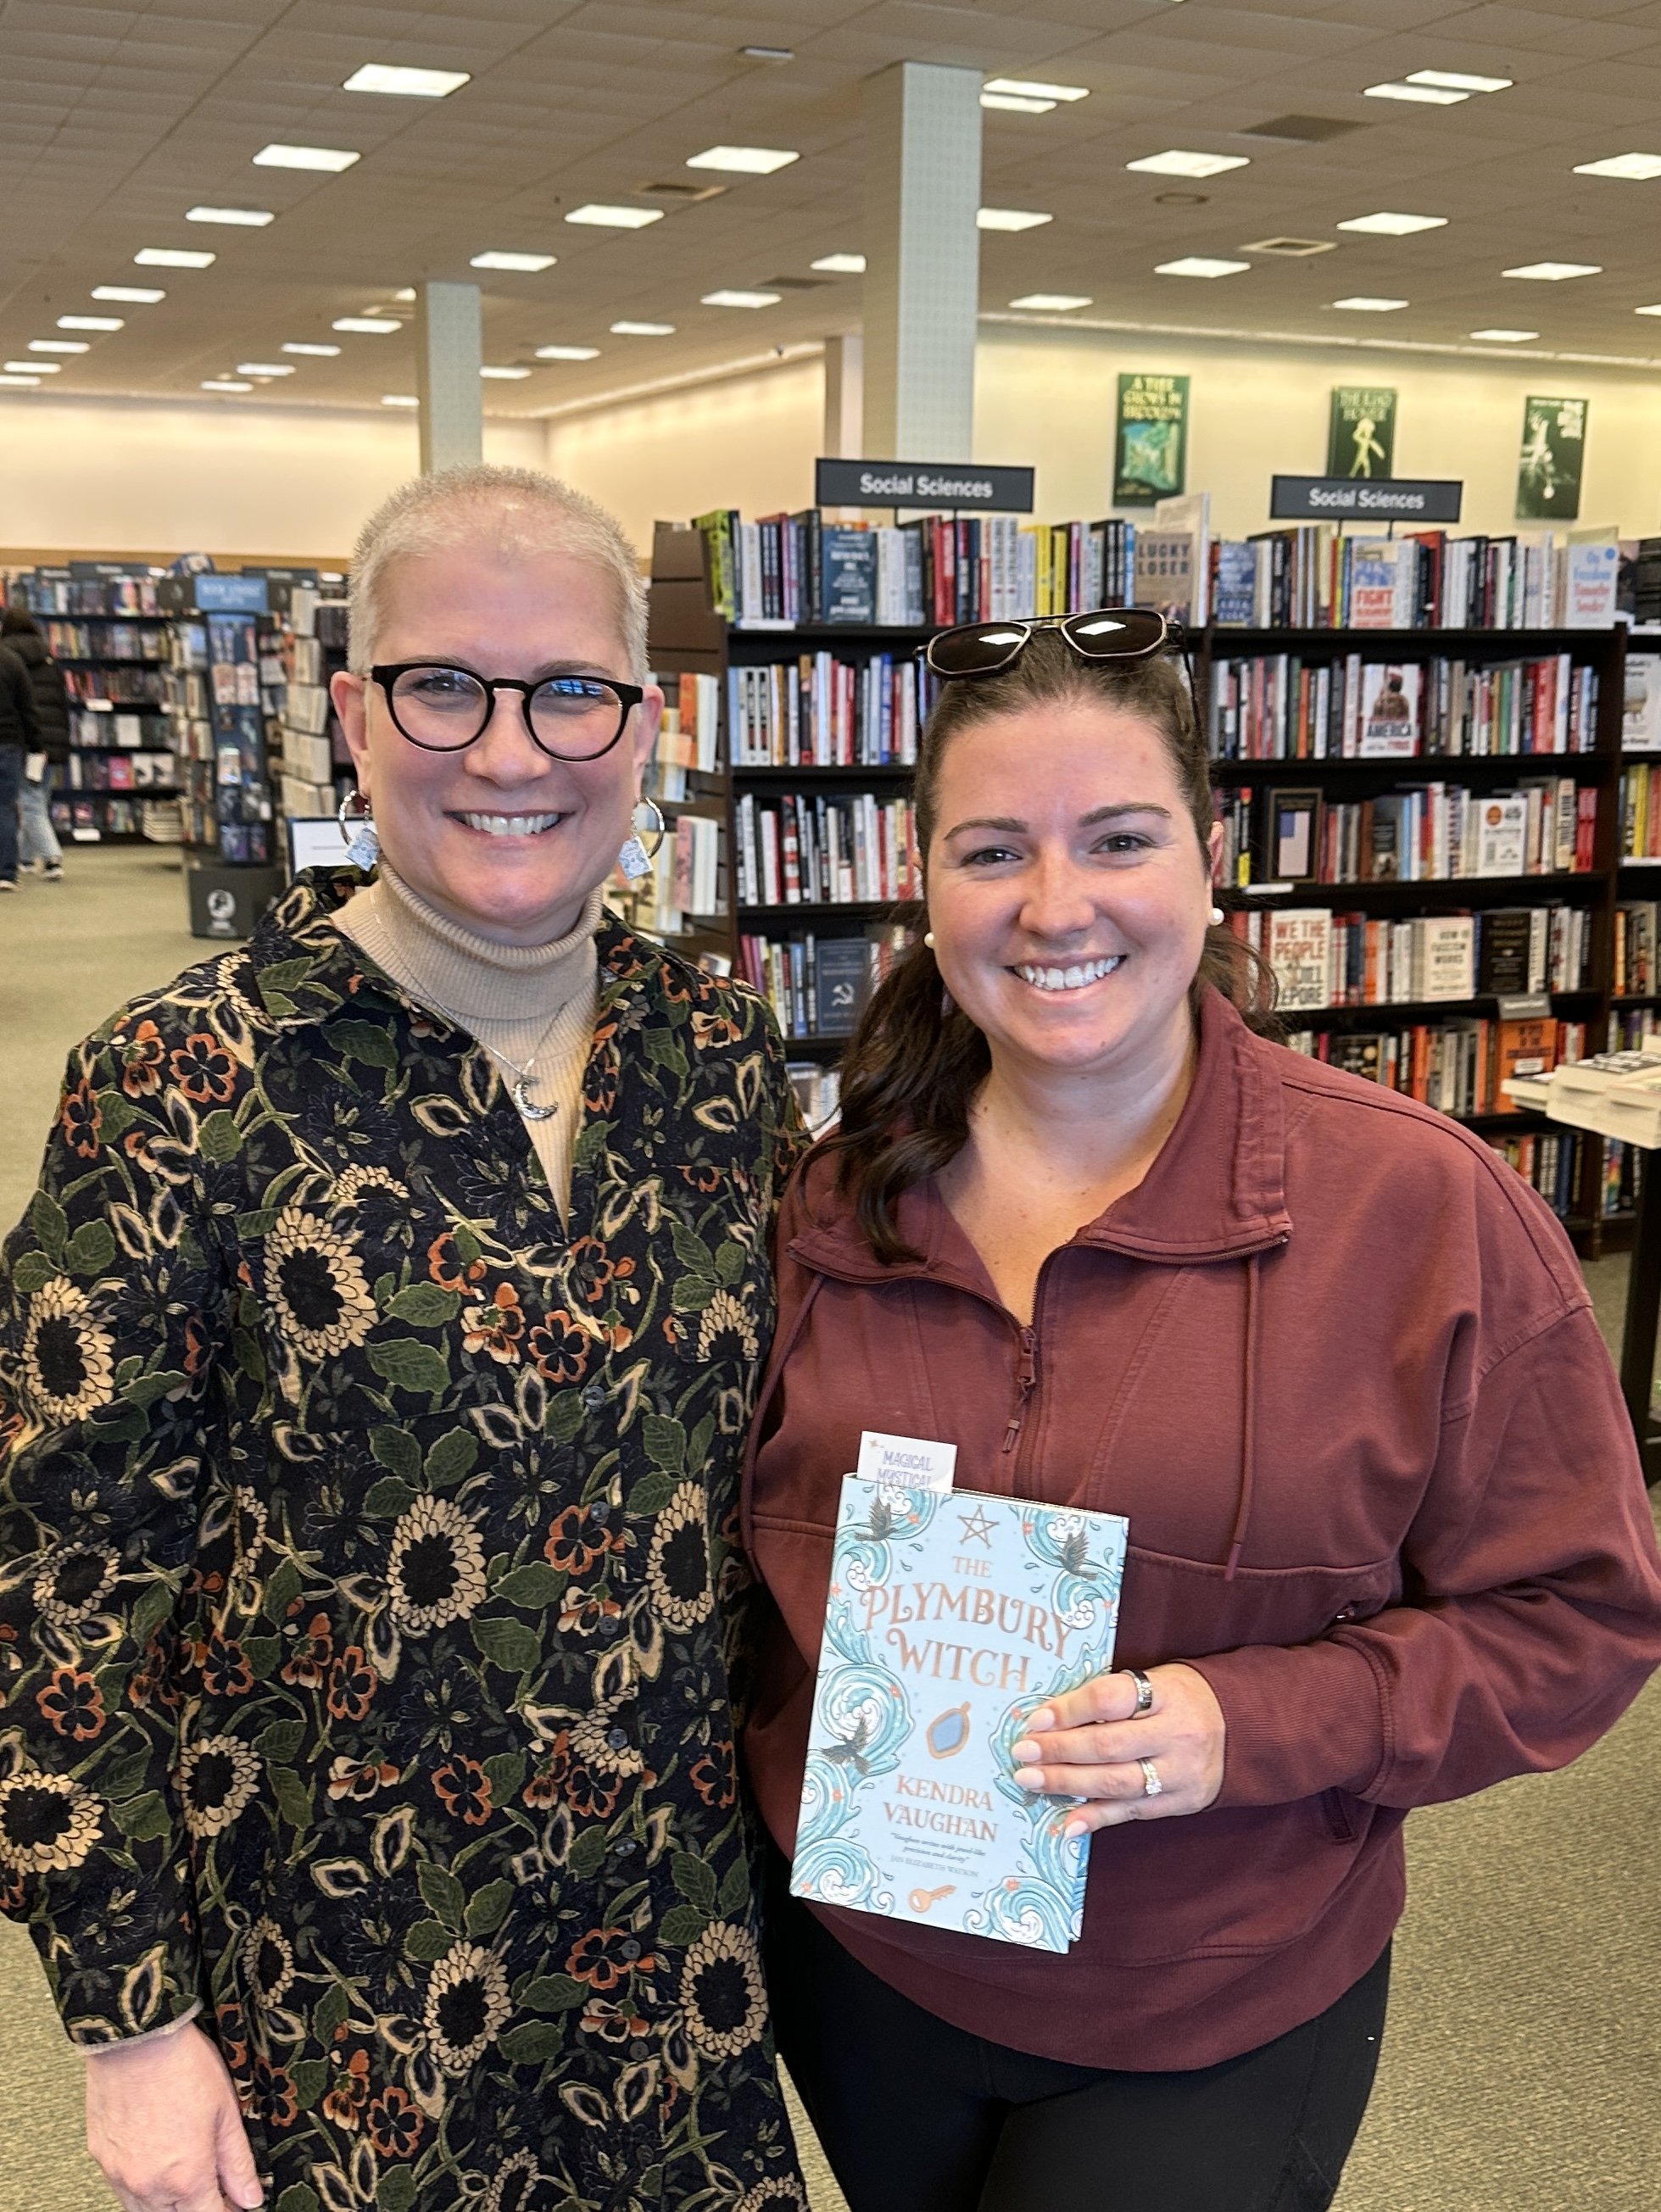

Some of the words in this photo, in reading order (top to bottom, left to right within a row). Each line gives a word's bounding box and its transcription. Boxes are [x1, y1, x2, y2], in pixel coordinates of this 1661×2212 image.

[859, 472, 913, 495] Social
[916, 474, 994, 499] Sciences
[1309, 487, 1356, 508] Social
[1357, 488, 1425, 510] Sciences
[1138, 543, 1190, 558] LUCKY
[1138, 560, 1189, 576] LOSER
[1275, 921, 1297, 939] WE
[1301, 919, 1324, 938] THE
[1274, 939, 1324, 961] PEOPLE
[1275, 986, 1324, 1006] EPORE
[882, 1450, 934, 1471] MAGICAL
[876, 1468, 932, 1490] MYSTICAL
[951, 1556, 994, 1579] THE
[859, 1582, 1077, 1661] PLYMBURY
[885, 1627, 1032, 1693] WITCH
[895, 1774, 994, 1812] KENDRA
[883, 1802, 1000, 1842] VAUGHAN
